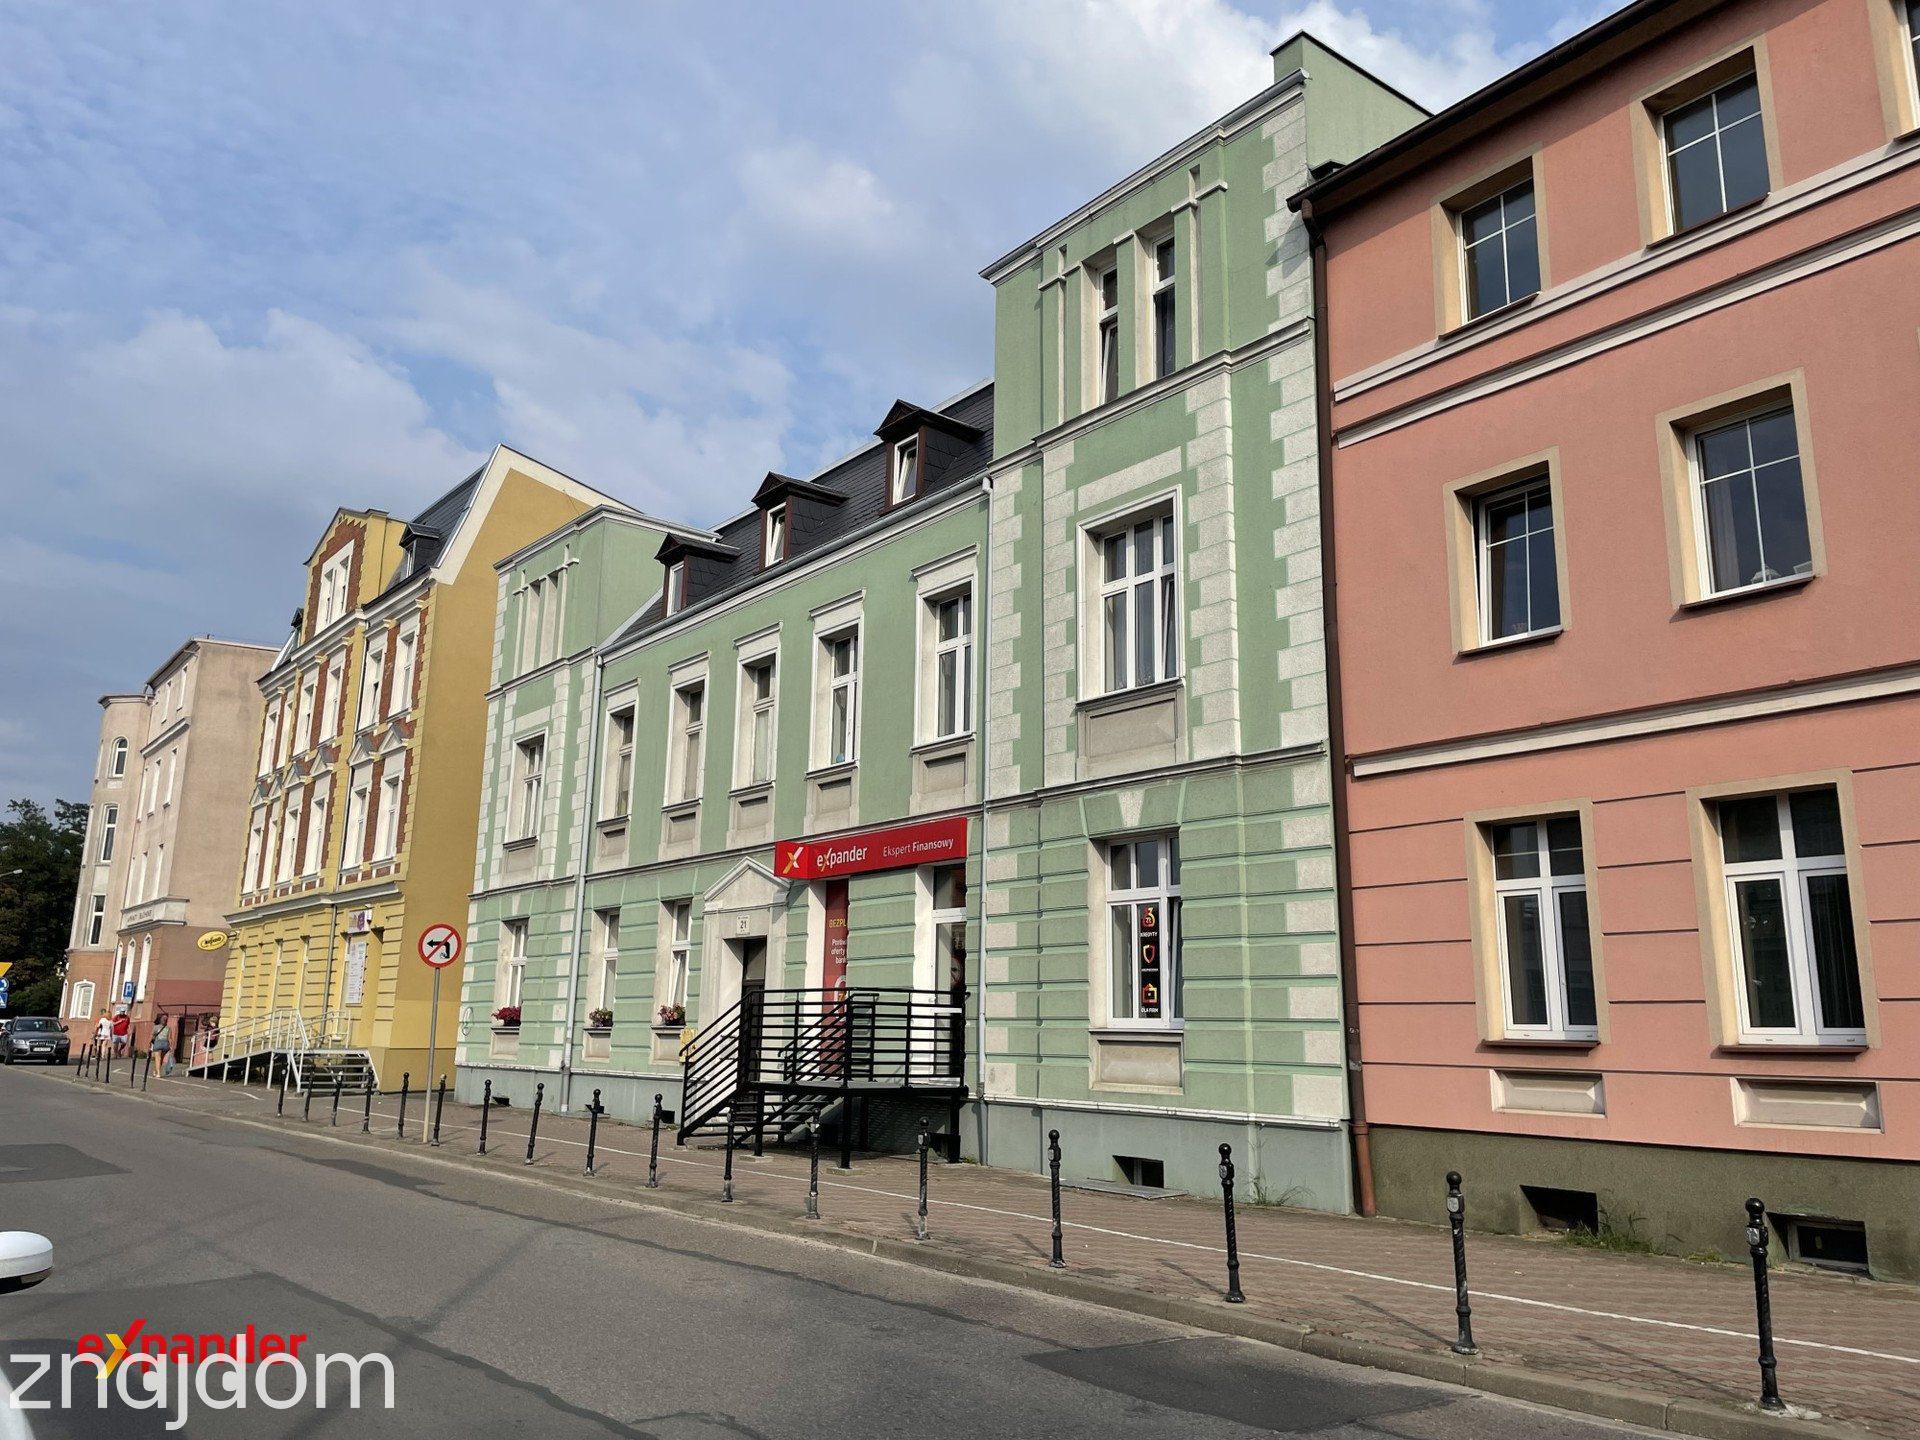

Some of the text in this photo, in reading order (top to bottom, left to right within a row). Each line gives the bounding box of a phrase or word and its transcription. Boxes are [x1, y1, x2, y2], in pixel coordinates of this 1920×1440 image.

[882, 845, 911, 857] Ekspert
[911, 838, 954, 852] Finansowy
[739, 920, 748, 930] 21
